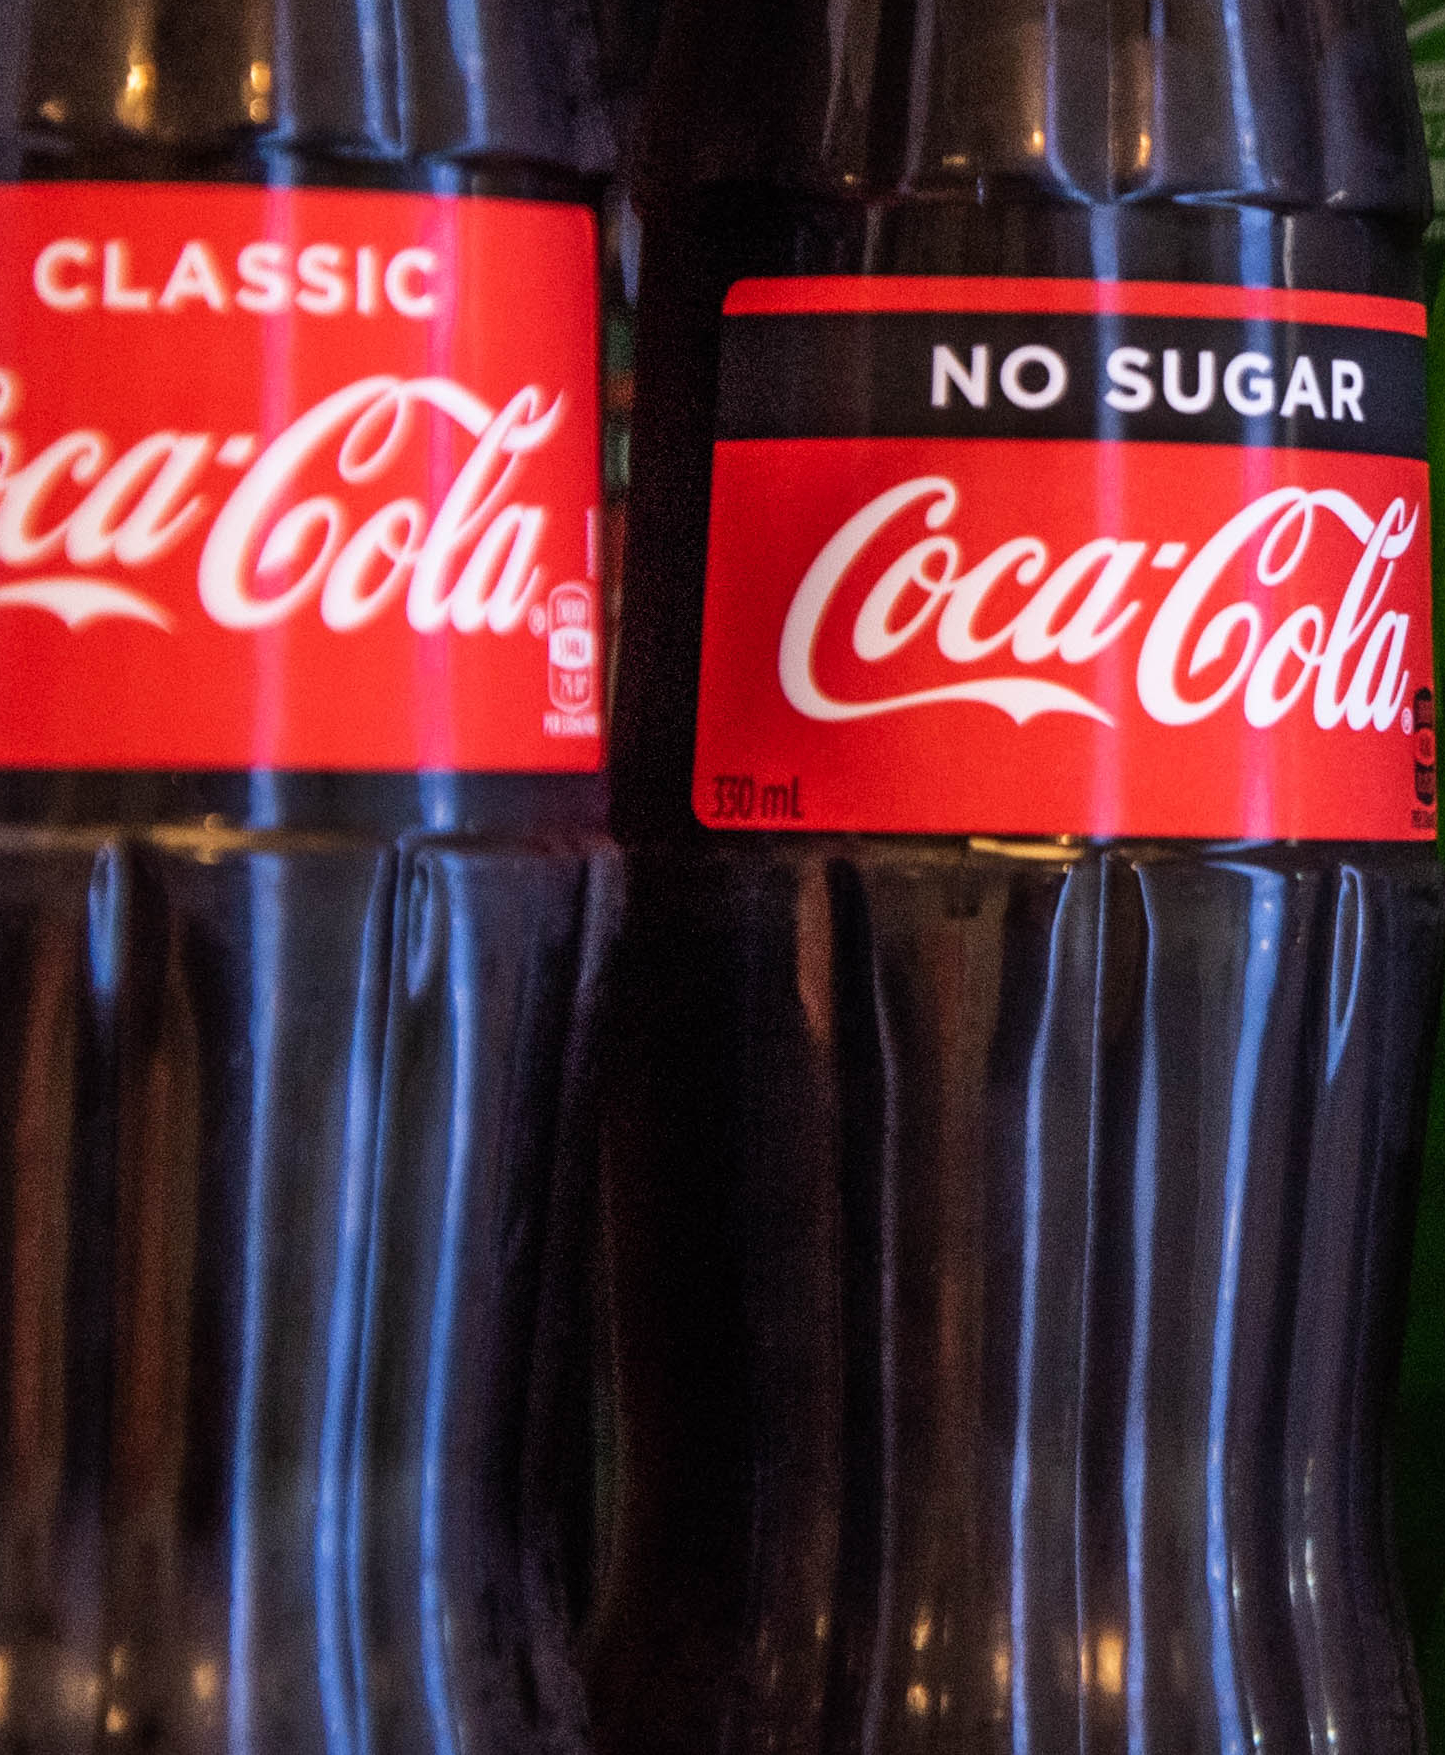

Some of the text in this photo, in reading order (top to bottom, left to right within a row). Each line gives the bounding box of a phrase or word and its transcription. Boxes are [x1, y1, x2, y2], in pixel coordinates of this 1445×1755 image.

[32, 238, 440, 317] CLASSIC
[930, 343, 1365, 423] NO SUGAR
[778, 474, 1419, 732] Coca-Cola
[712, 774, 804, 820] 330 mL
